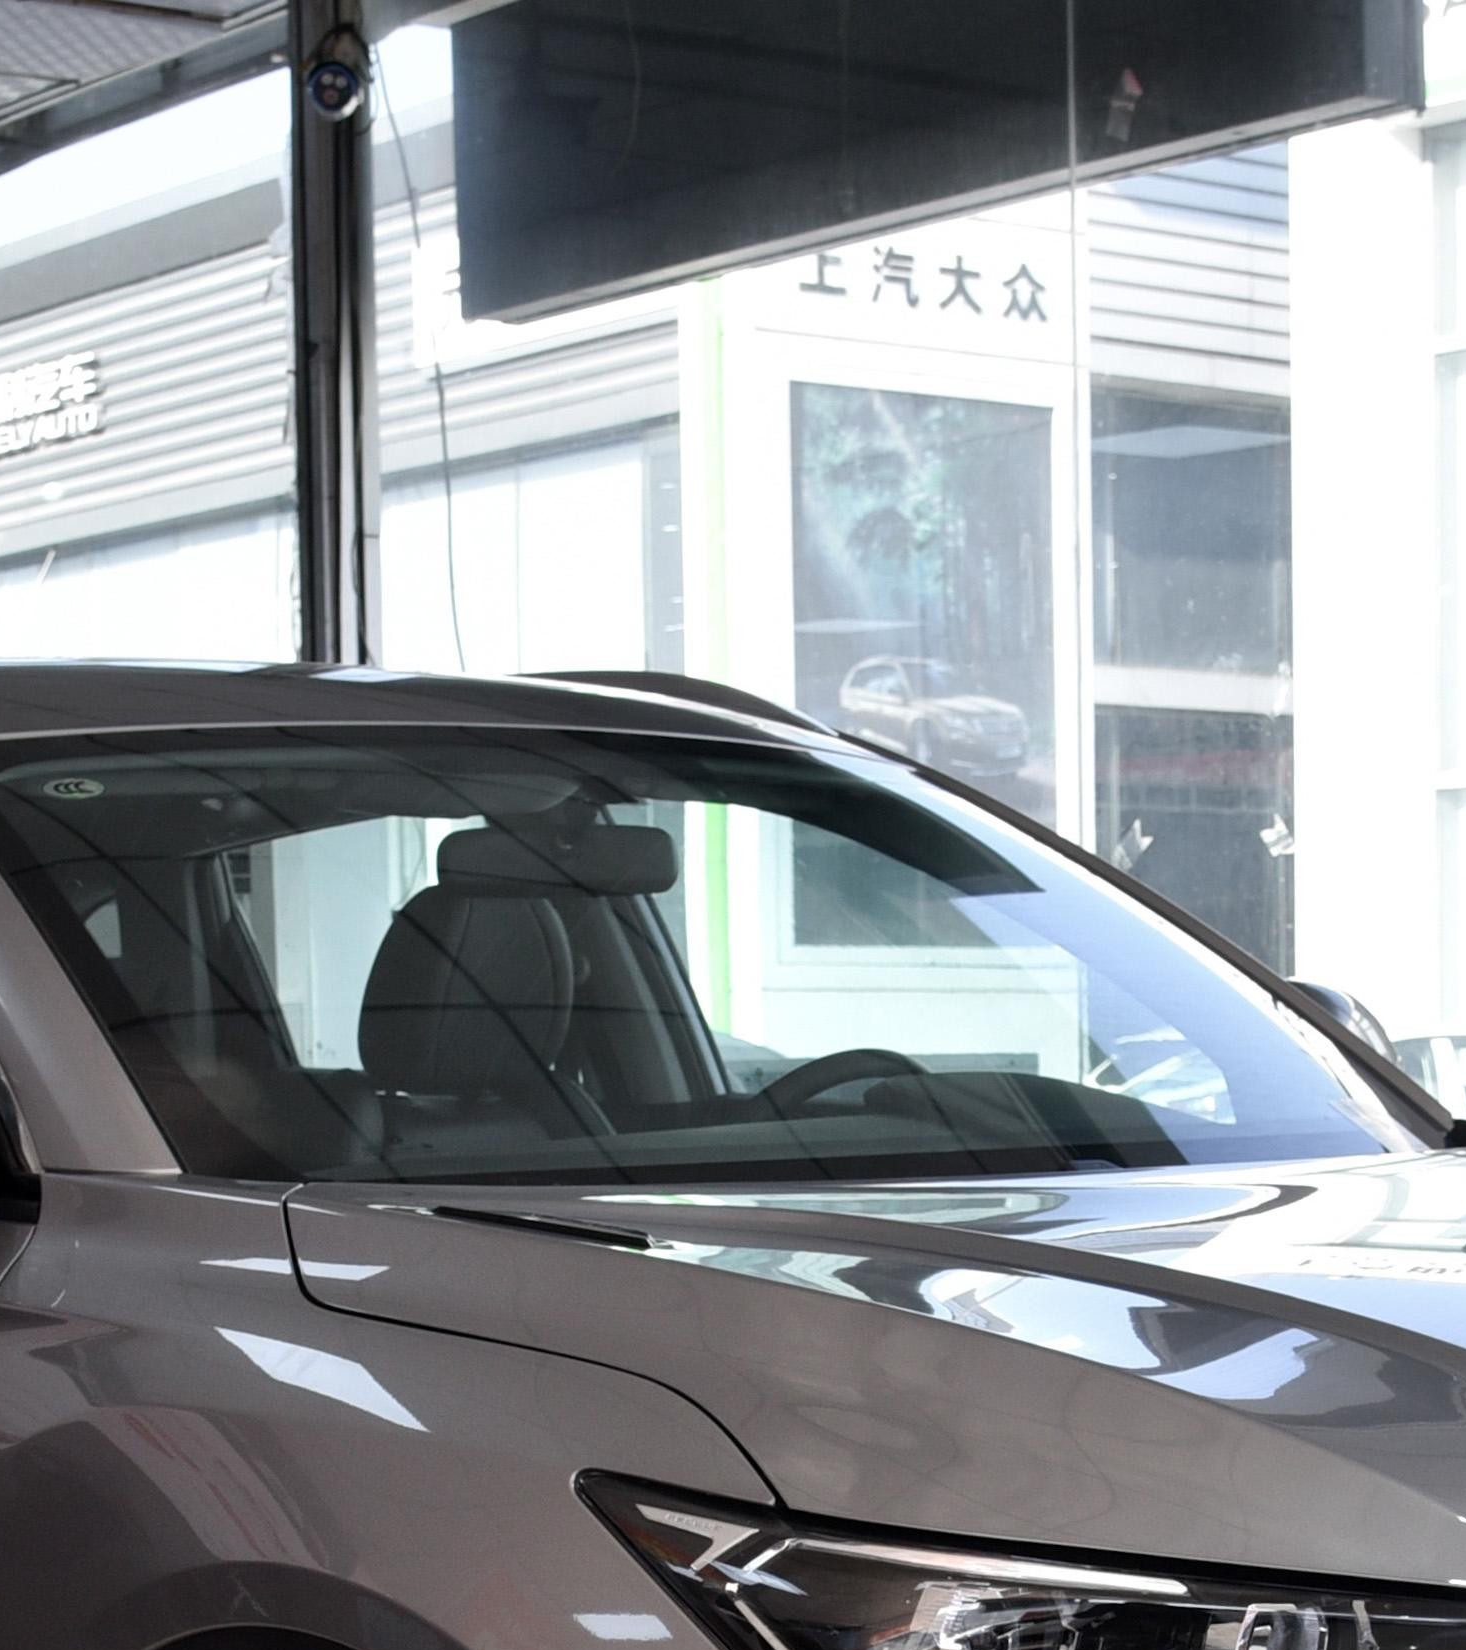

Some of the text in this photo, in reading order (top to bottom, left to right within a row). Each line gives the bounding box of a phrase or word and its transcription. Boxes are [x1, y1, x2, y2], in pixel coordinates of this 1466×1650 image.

[799, 247, 1047, 322] 上汽大众
[32, 403, 99, 444] AUTO
